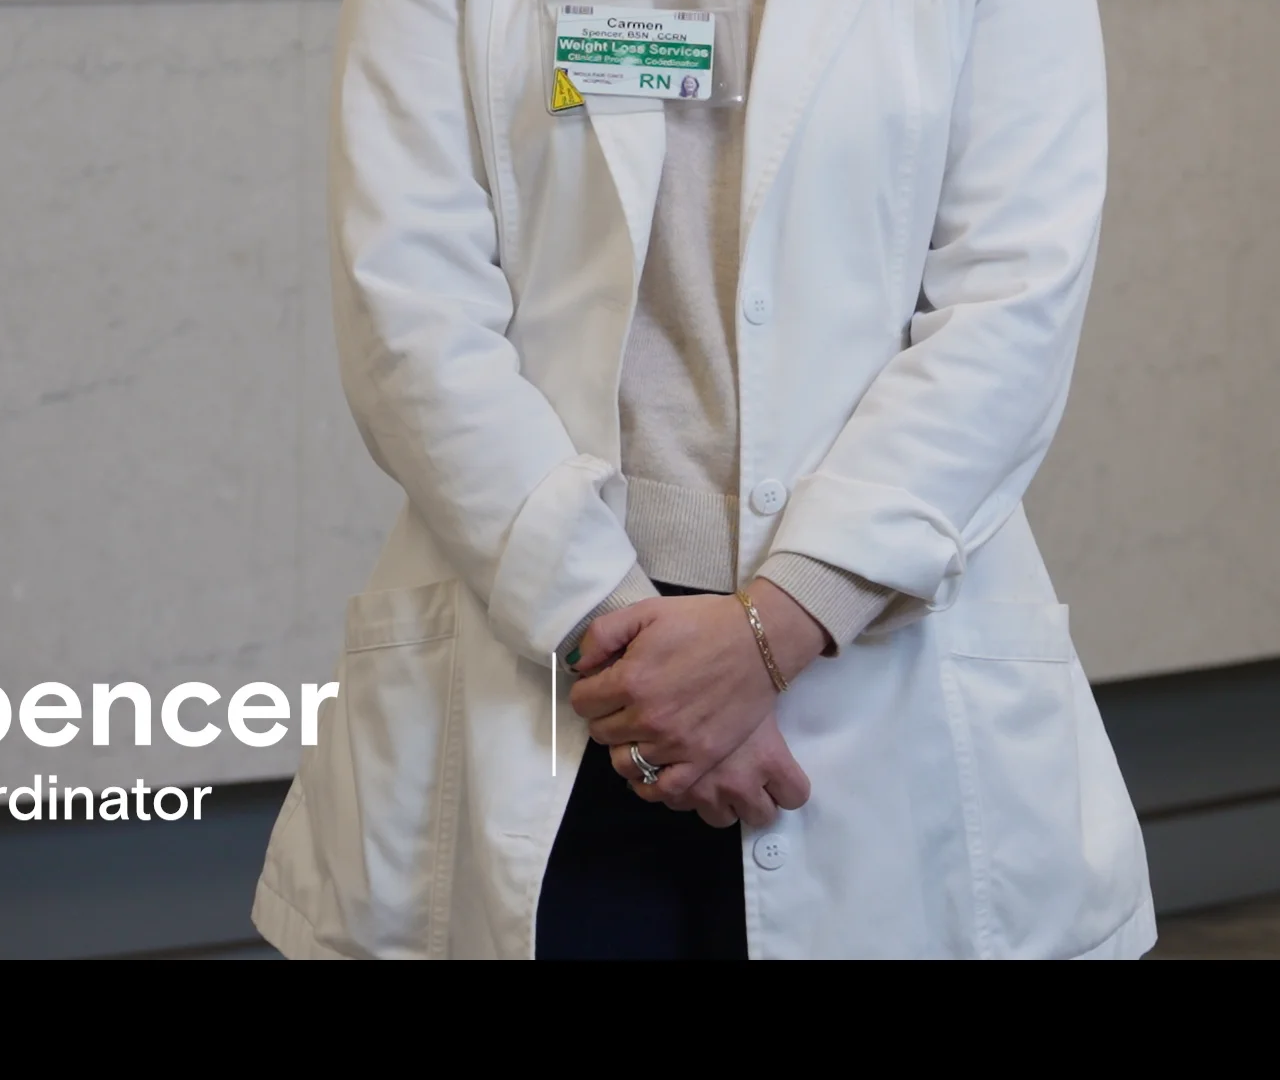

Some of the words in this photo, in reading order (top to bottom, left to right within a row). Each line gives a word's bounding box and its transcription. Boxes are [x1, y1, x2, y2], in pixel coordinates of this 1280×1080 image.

[607, 17, 663, 31] Carmen
[627, 30, 649, 40] BSN
[657, 32, 687, 42] CCRN
[559, 38, 608, 54] Weight
[612, 41, 646, 55] Loss
[649, 43, 709, 58] Services
[639, 73, 672, 90] RN
